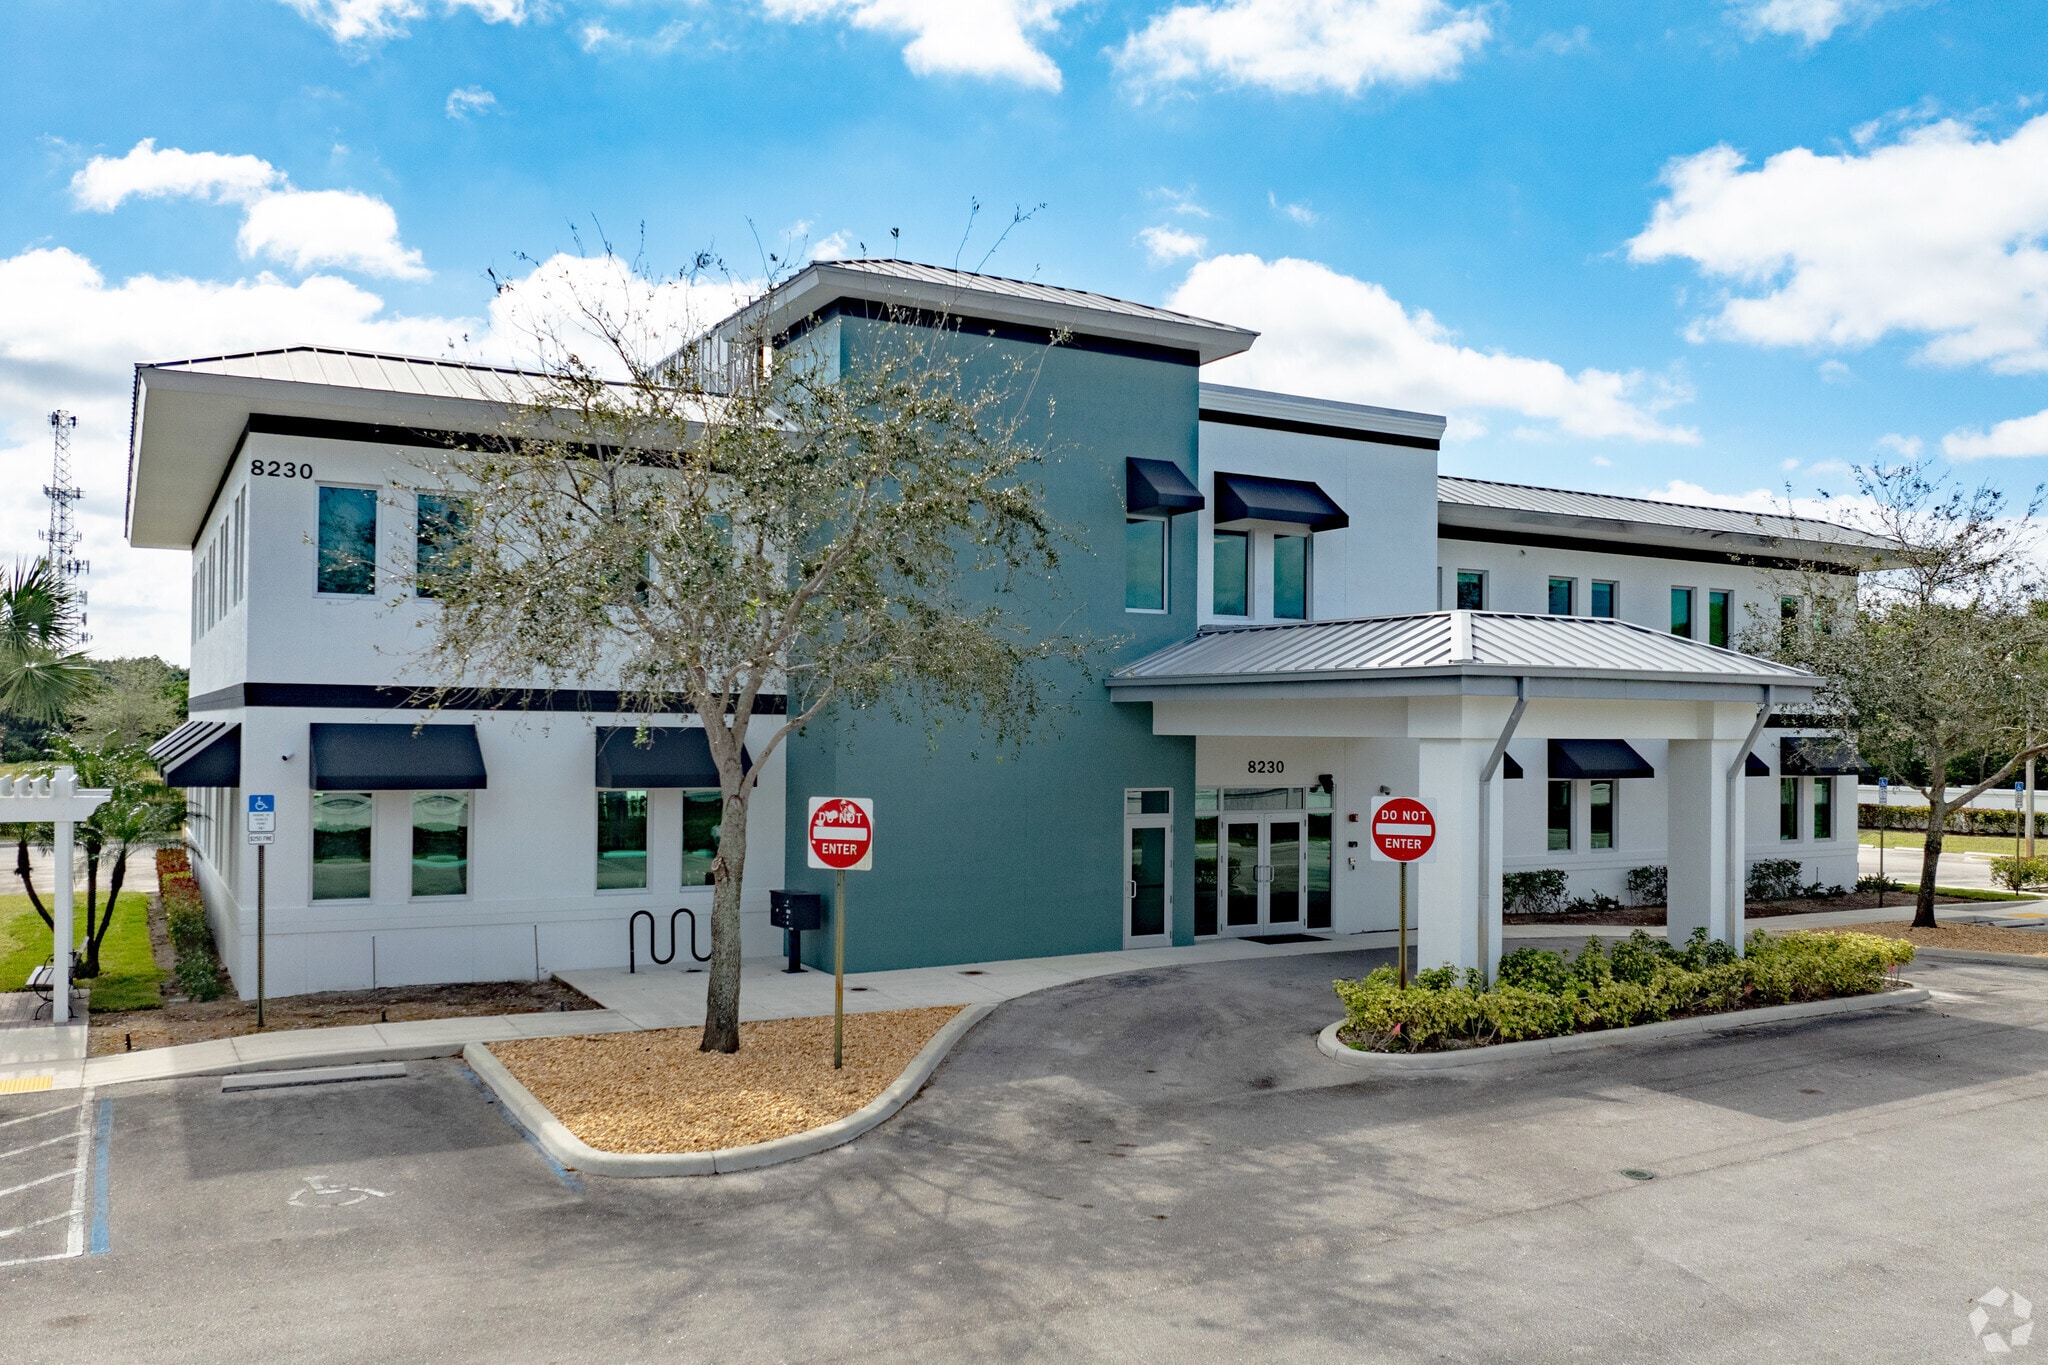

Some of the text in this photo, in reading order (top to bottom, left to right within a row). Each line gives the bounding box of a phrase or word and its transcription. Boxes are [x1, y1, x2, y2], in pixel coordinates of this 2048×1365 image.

[251, 460, 313, 479] 8230
[1248, 760, 1285, 774] 8230
[839, 812, 863, 825] NOT
[1381, 810, 1427, 821] DO NOT
[822, 843, 857, 856] ENTER
[1385, 838, 1422, 849] ENTER
